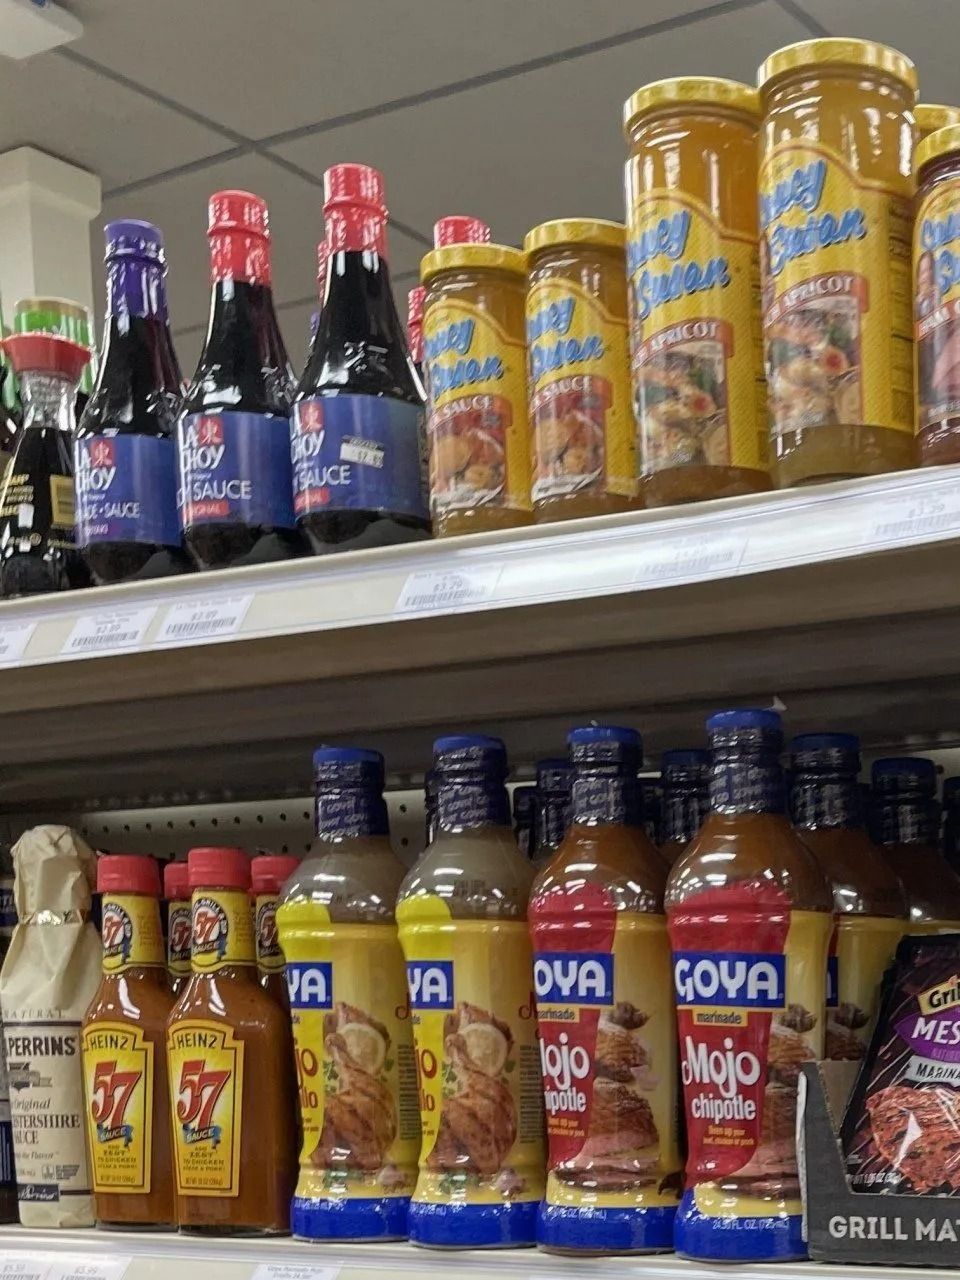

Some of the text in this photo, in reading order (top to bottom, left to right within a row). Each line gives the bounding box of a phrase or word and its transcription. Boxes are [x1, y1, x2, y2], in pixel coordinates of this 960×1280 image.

[784, 275, 853, 306] APRICOT
[651, 321, 717, 350] APRICOT
[193, 475, 252, 501] SAUCE
[300, 464, 351, 490] SAUCE
[104, 501, 141, 518] SAUCE
[534, 958, 606, 998] OYA
[674, 957, 780, 1002] GOYA
[696, 1010, 742, 1025] marinade
[8, 1036, 77, 1057] PERRINS
[89, 1033, 128, 1050] HEINZ
[176, 1032, 218, 1050] HEINZ
[92, 1060, 142, 1130] 57
[178, 1058, 231, 1131] 57
[691, 1093, 757, 1124] chipotle
[828, 1215, 908, 1242] GRILL
